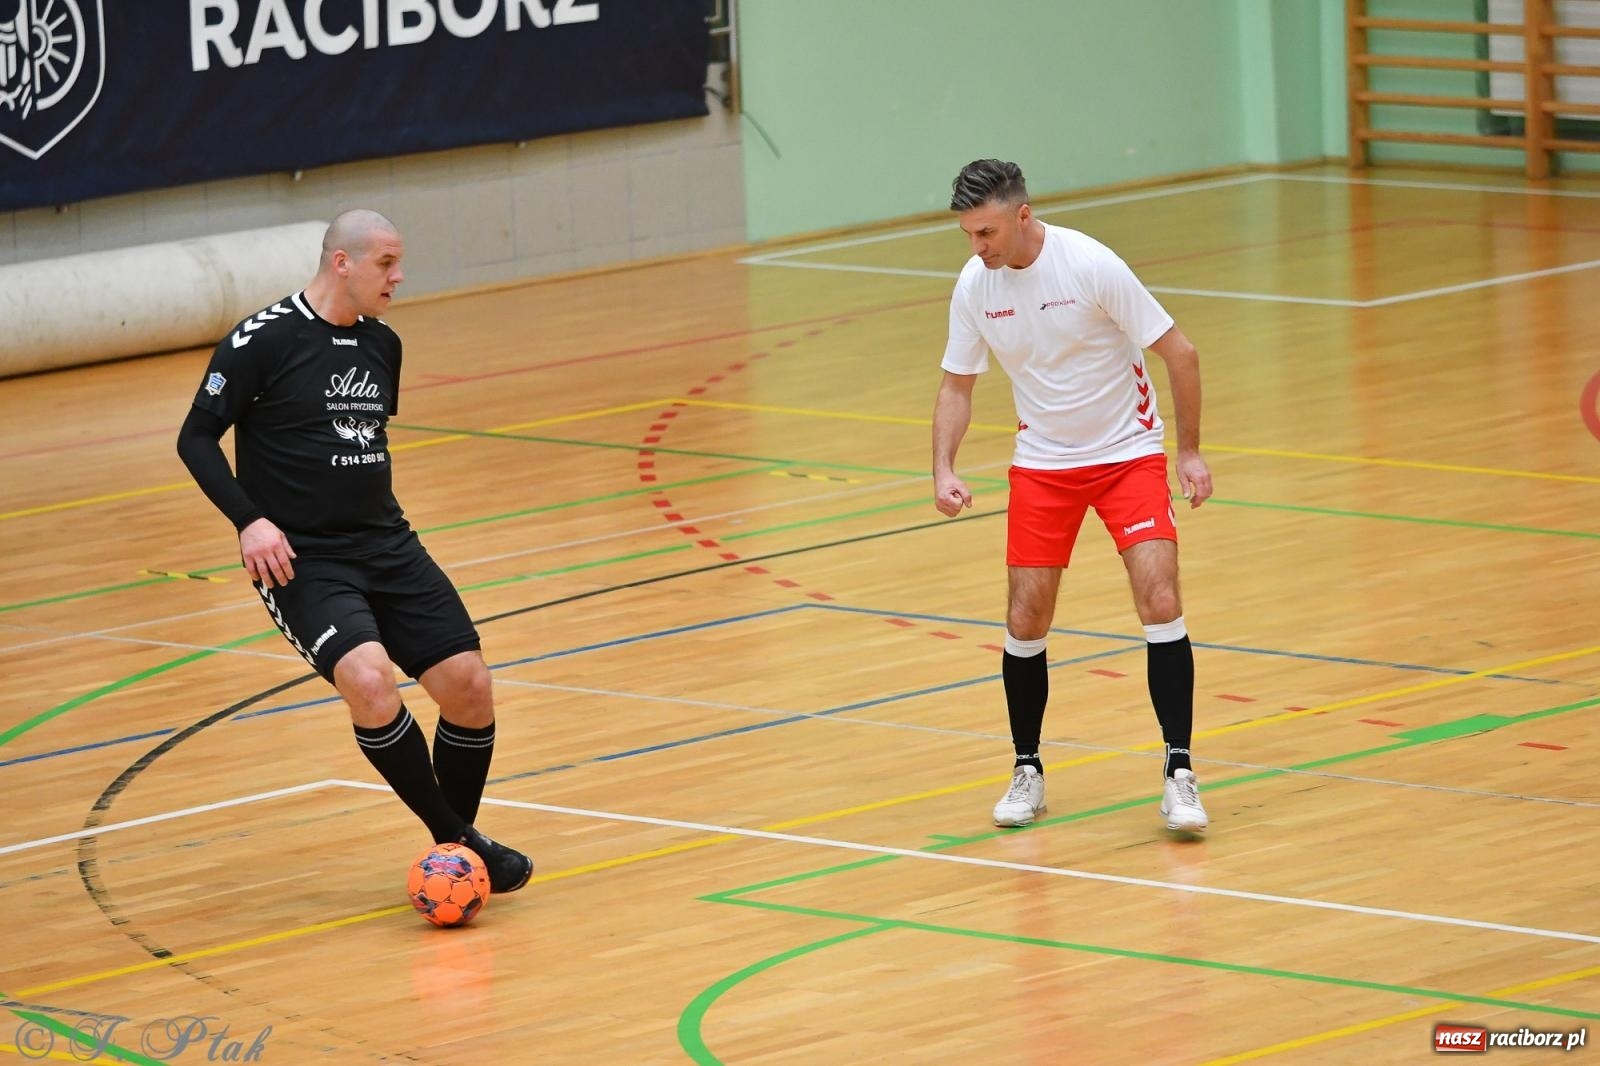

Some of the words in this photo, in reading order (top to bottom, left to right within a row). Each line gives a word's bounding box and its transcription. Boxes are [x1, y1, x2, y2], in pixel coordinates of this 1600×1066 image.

[189, 0, 600, 72] RACIB
[985, 308, 1016, 319] humme
[325, 366, 380, 398] Ada
[326, 402, 350, 411] SALON
[341, 455, 360, 466] 514
[361, 453, 376, 464] 260
[1123, 517, 1155, 536] hummel
[310, 624, 338, 656] hummel
